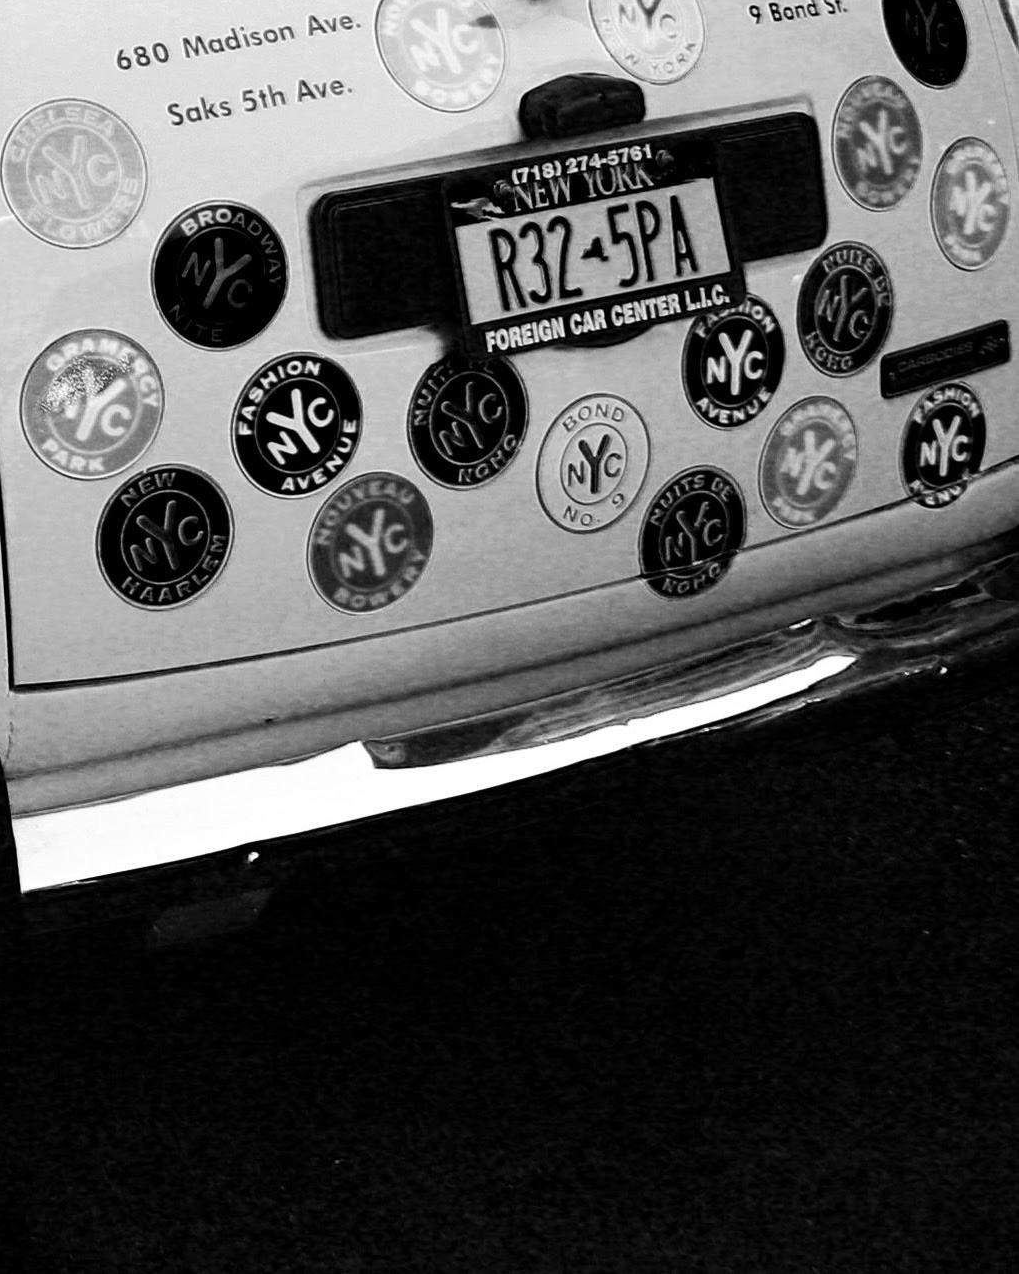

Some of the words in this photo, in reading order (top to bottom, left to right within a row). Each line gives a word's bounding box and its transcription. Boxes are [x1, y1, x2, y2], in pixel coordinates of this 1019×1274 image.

[116, 41, 170, 71] 680
[182, 24, 296, 59] Madison
[307, 14, 362, 37] Ave.
[410, 8, 479, 74] NYC
[748, 4, 762, 25] 9
[11, 106, 115, 163] CHELSEA
[167, 96, 232, 126] Saks
[241, 84, 287, 113] 5th
[296, 78, 353, 103] Ave.
[35, 135, 116, 209] NYC
[511, 160, 562, 186] (718)
[565, 143, 653, 175] 274-5761
[858, 109, 908, 177] NYC
[512, 173, 573, 212] NEW
[581, 163, 655, 198] YORK
[181, 236, 254, 309] NYC
[182, 208, 282, 284] BROADWAY
[488, 214, 583, 312] R32
[606, 193, 700, 288] 5PA
[822, 249, 874, 273] NUITS
[484, 316, 567, 354] FOREIGN
[568, 308, 610, 337] CAR
[610, 293, 682, 328] CENTER
[684, 283, 731, 312] L.I.C.
[817, 275, 874, 343] NYC
[46, 337, 161, 409] GRAMERCY
[705, 328, 765, 397] NYC
[237, 360, 321, 437] FASHION
[265, 387, 335, 466] NYC
[440, 381, 502, 456] NYC
[562, 403, 626, 433] BOND
[695, 387, 774, 425] AVENUE
[914, 387, 981, 424] FASHION
[41, 437, 105, 473] PARK
[281, 418, 358, 492] AVENUE
[457, 433, 518, 484] NOHO
[567, 433, 622, 495] NYC
[781, 430, 838, 496] NYC
[920, 415, 969, 478] NYC
[121, 471, 178, 507] NEW
[611, 492, 625, 506] 9
[650, 474, 705, 526] NUITS
[711, 477, 735, 502] DE
[129, 499, 204, 572] NYC
[339, 508, 408, 578] NYC
[665, 500, 724, 566] NYC
[121, 534, 227, 604] HAARLEM
